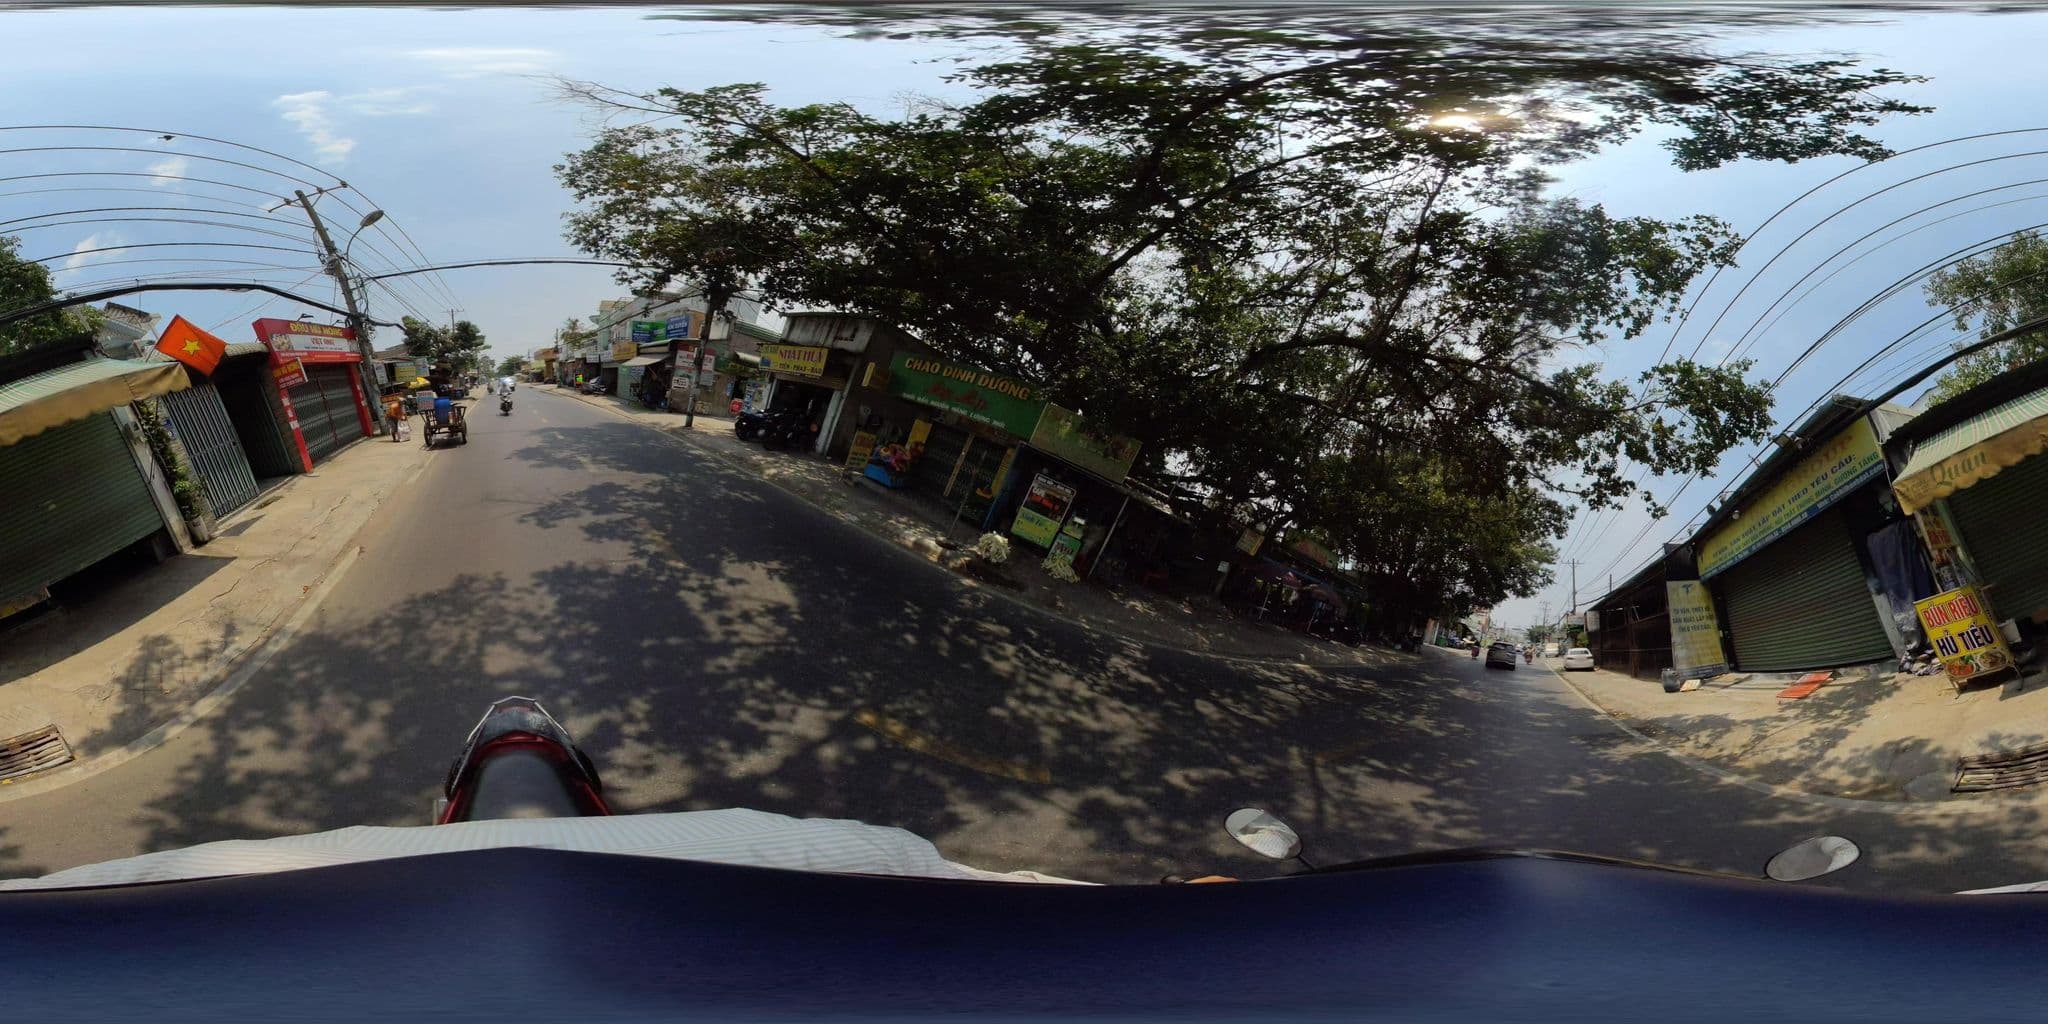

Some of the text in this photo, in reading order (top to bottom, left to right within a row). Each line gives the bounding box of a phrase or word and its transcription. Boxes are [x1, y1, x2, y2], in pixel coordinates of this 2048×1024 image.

[1922, 592, 1980, 629] BÚN RIÊU
[1936, 621, 1995, 657] HỦ TIẾU
